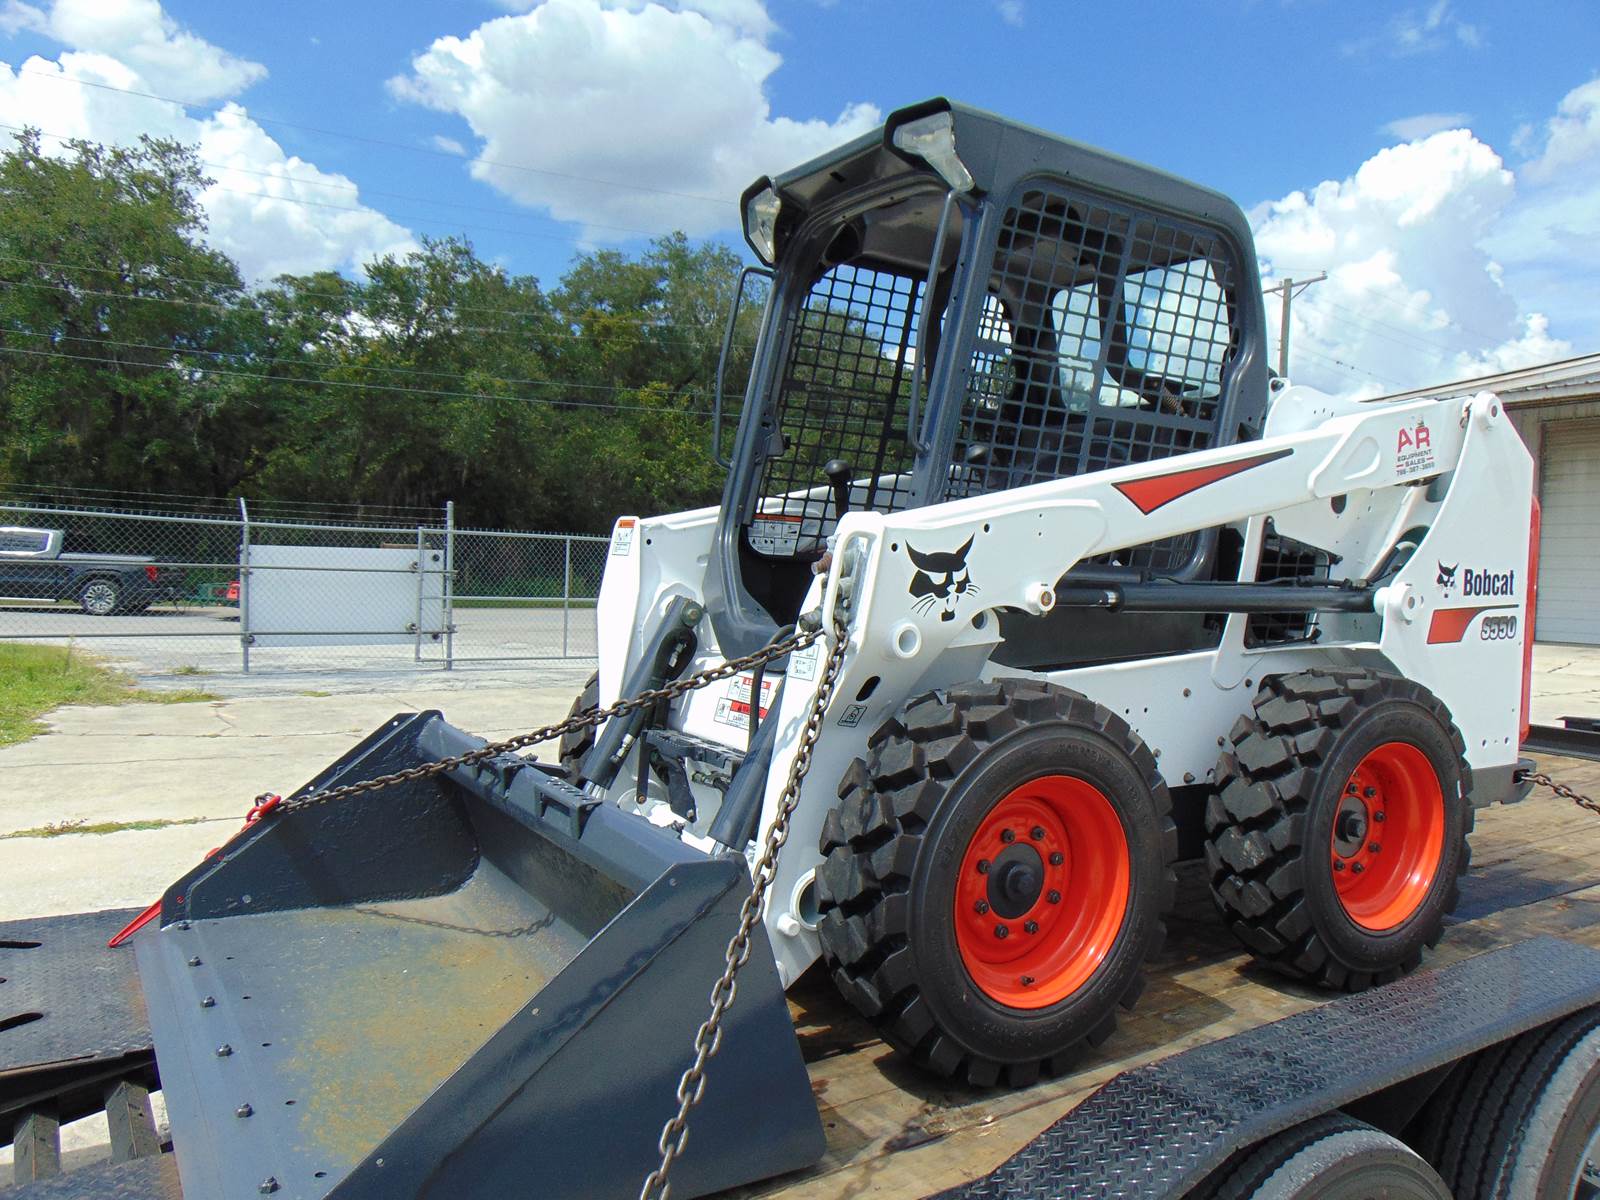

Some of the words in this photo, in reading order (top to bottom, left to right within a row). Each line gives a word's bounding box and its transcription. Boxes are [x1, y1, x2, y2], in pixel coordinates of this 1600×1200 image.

[1397, 449, 1432, 462] EQUIPMENT
[1405, 458, 1426, 467] SALES
[1463, 568, 1515, 596] Bobcat
[1481, 615, 1517, 640] S550
